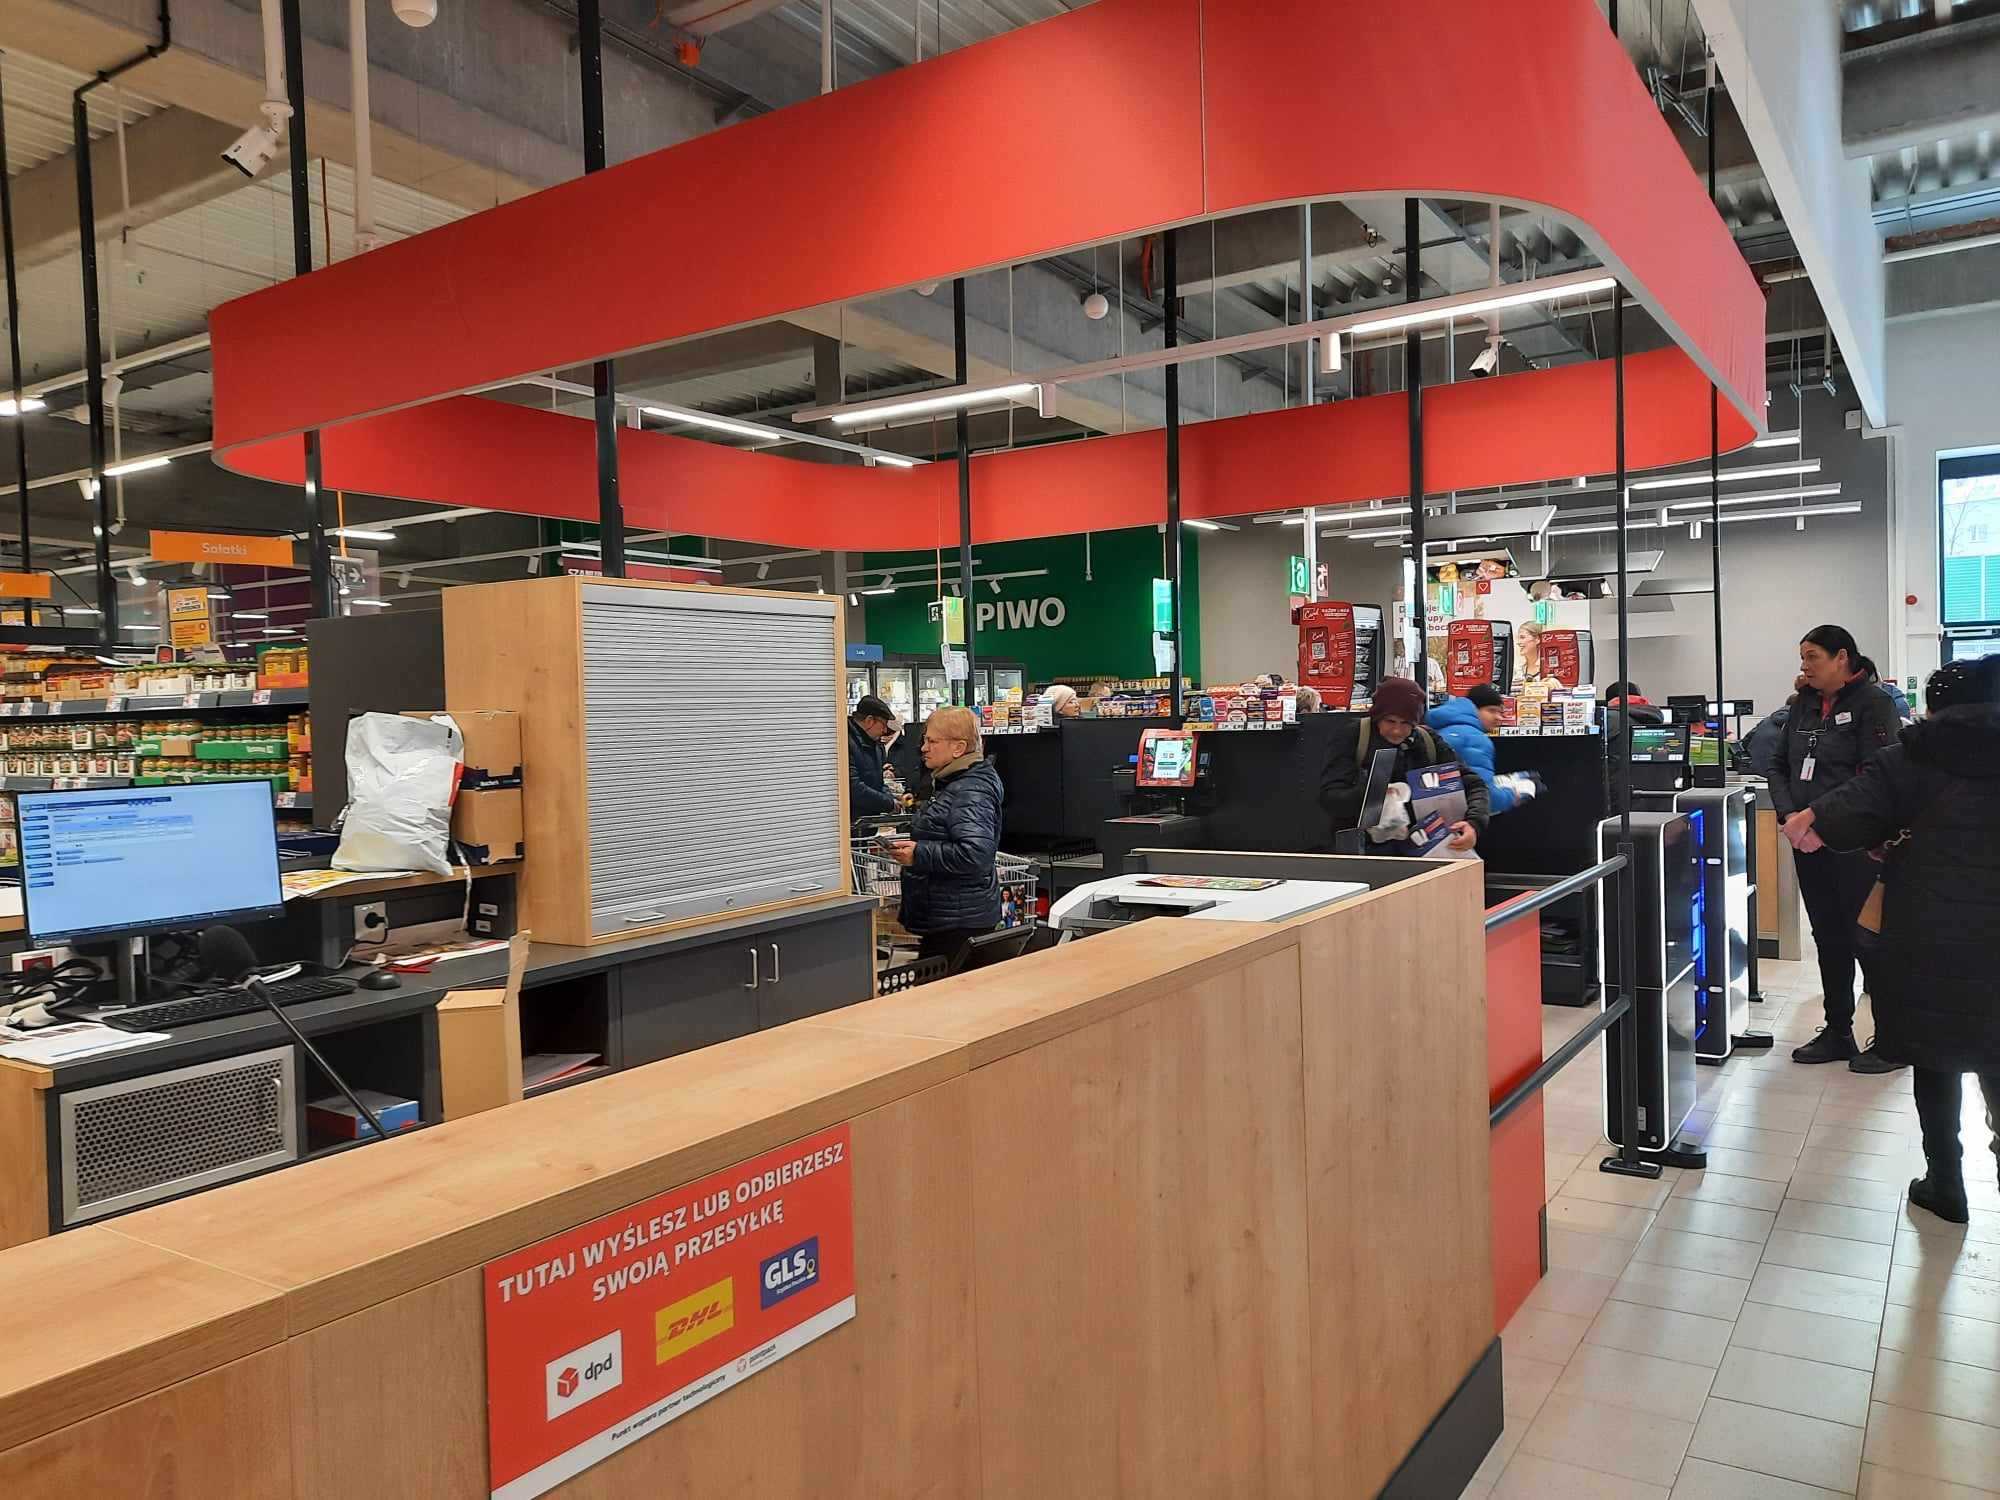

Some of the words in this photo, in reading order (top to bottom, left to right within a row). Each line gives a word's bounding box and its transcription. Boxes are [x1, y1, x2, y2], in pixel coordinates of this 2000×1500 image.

[976, 596, 1066, 632] PIWO
[498, 1252, 576, 1303] TUTAJ
[582, 1206, 687, 1269] WYŚLESZ
[693, 1189, 730, 1223] LUB
[735, 1142, 844, 1203] ODBIERZESZ
[592, 1251, 670, 1301] SWOJĄ
[675, 1199, 785, 1266] PRZESYŁKĘ
[765, 1249, 806, 1290] GLS
[668, 1300, 722, 1341] DHL
[584, 1353, 613, 1381] dpd
[658, 1398, 682, 1418] partner
